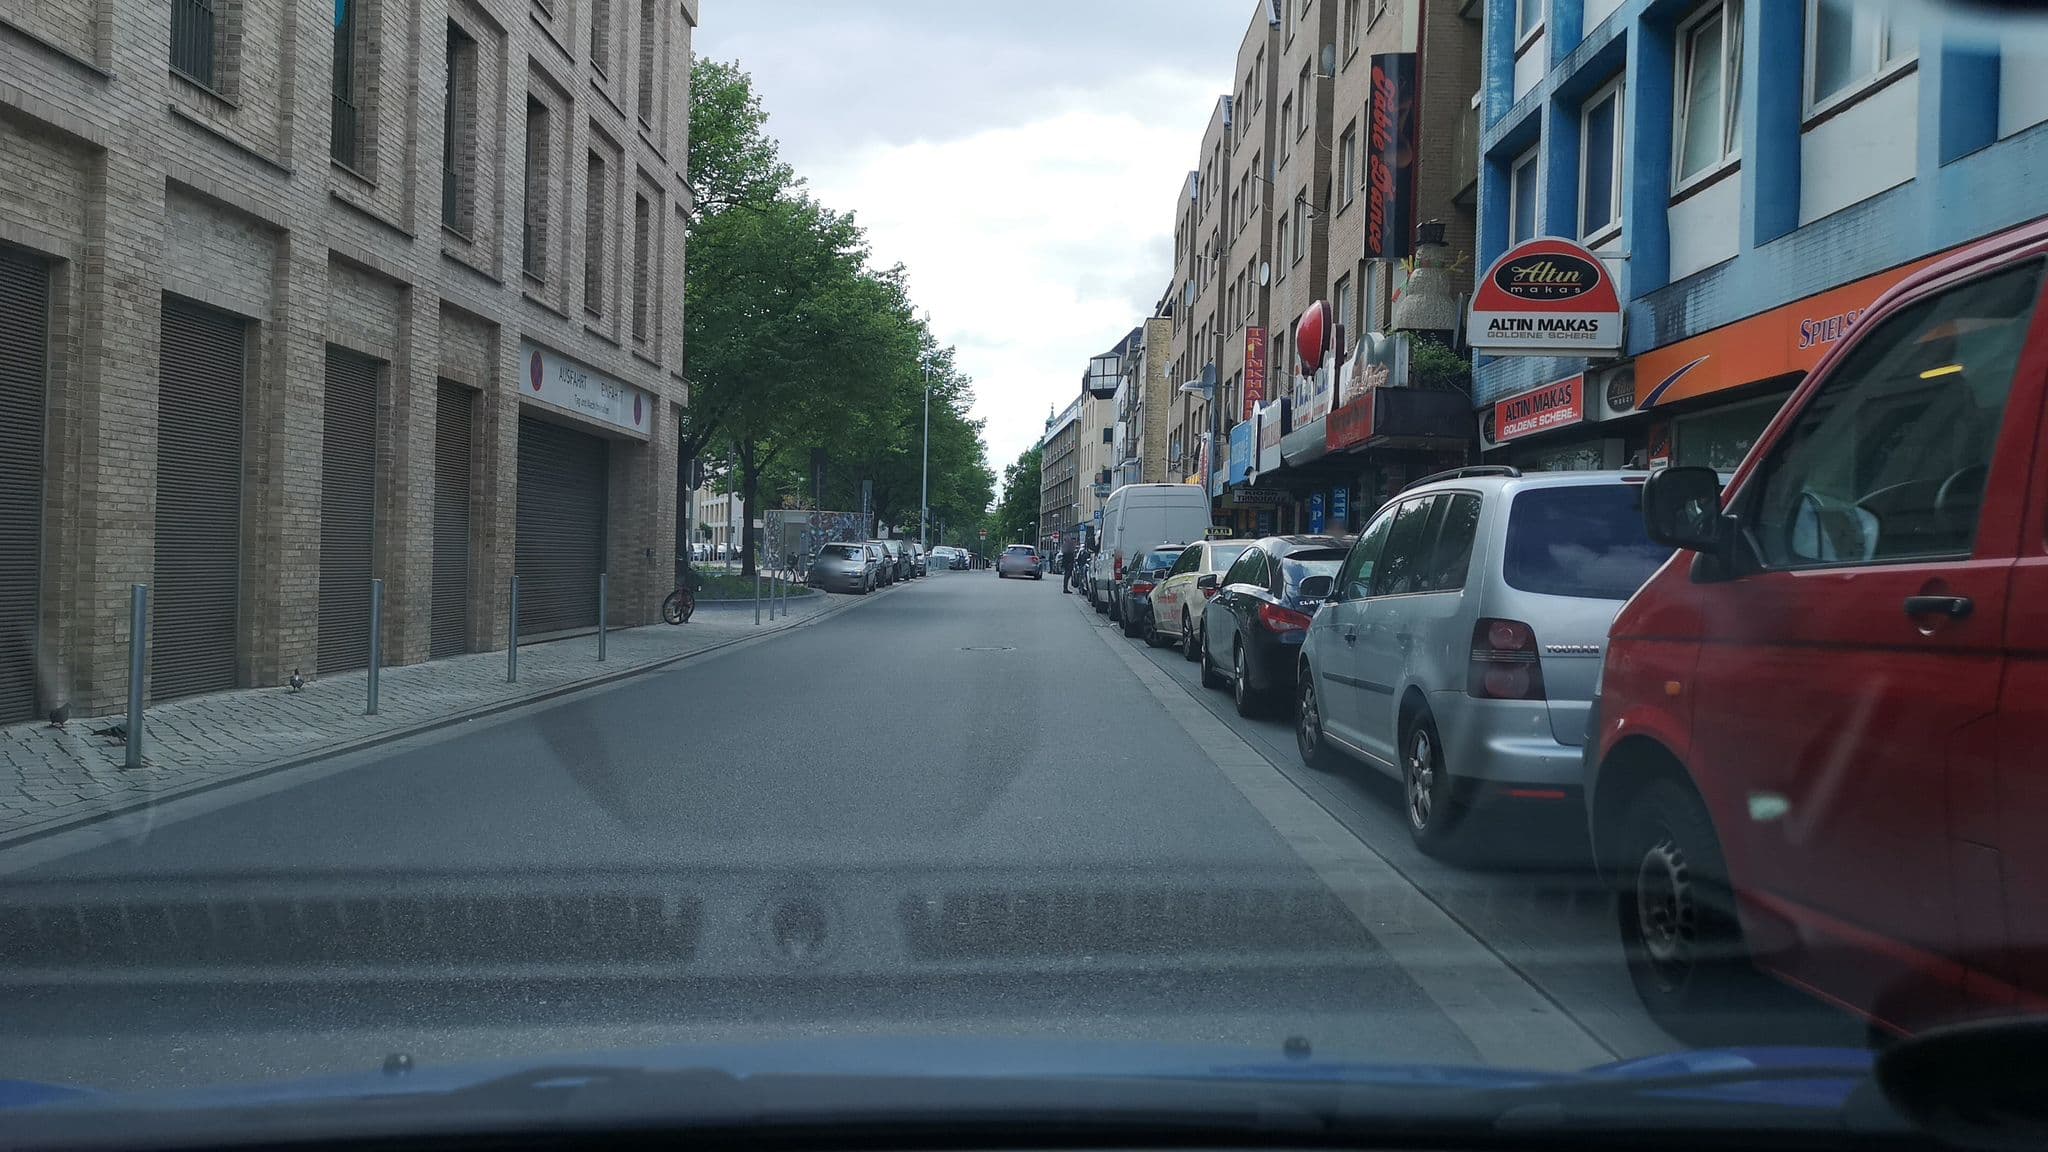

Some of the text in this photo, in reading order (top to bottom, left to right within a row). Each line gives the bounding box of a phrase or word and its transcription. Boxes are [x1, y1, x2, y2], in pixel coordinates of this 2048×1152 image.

[1369, 66, 1396, 254] Table Dance
[1510, 285, 1581, 294] makas
[1487, 331, 1597, 340] GOLDENE SCHERE
[1488, 318, 1598, 332] ALTIN MAKAS
[1799, 308, 1865, 350] SPIELS
[559, 365, 588, 389] AUSFAHRT
[1505, 384, 1572, 423] ALTIN MAKAS
[1503, 416, 1538, 436] GOLDENE
[1539, 407, 1573, 426] SCHERE
[1545, 644, 1600, 654] TOURAN
